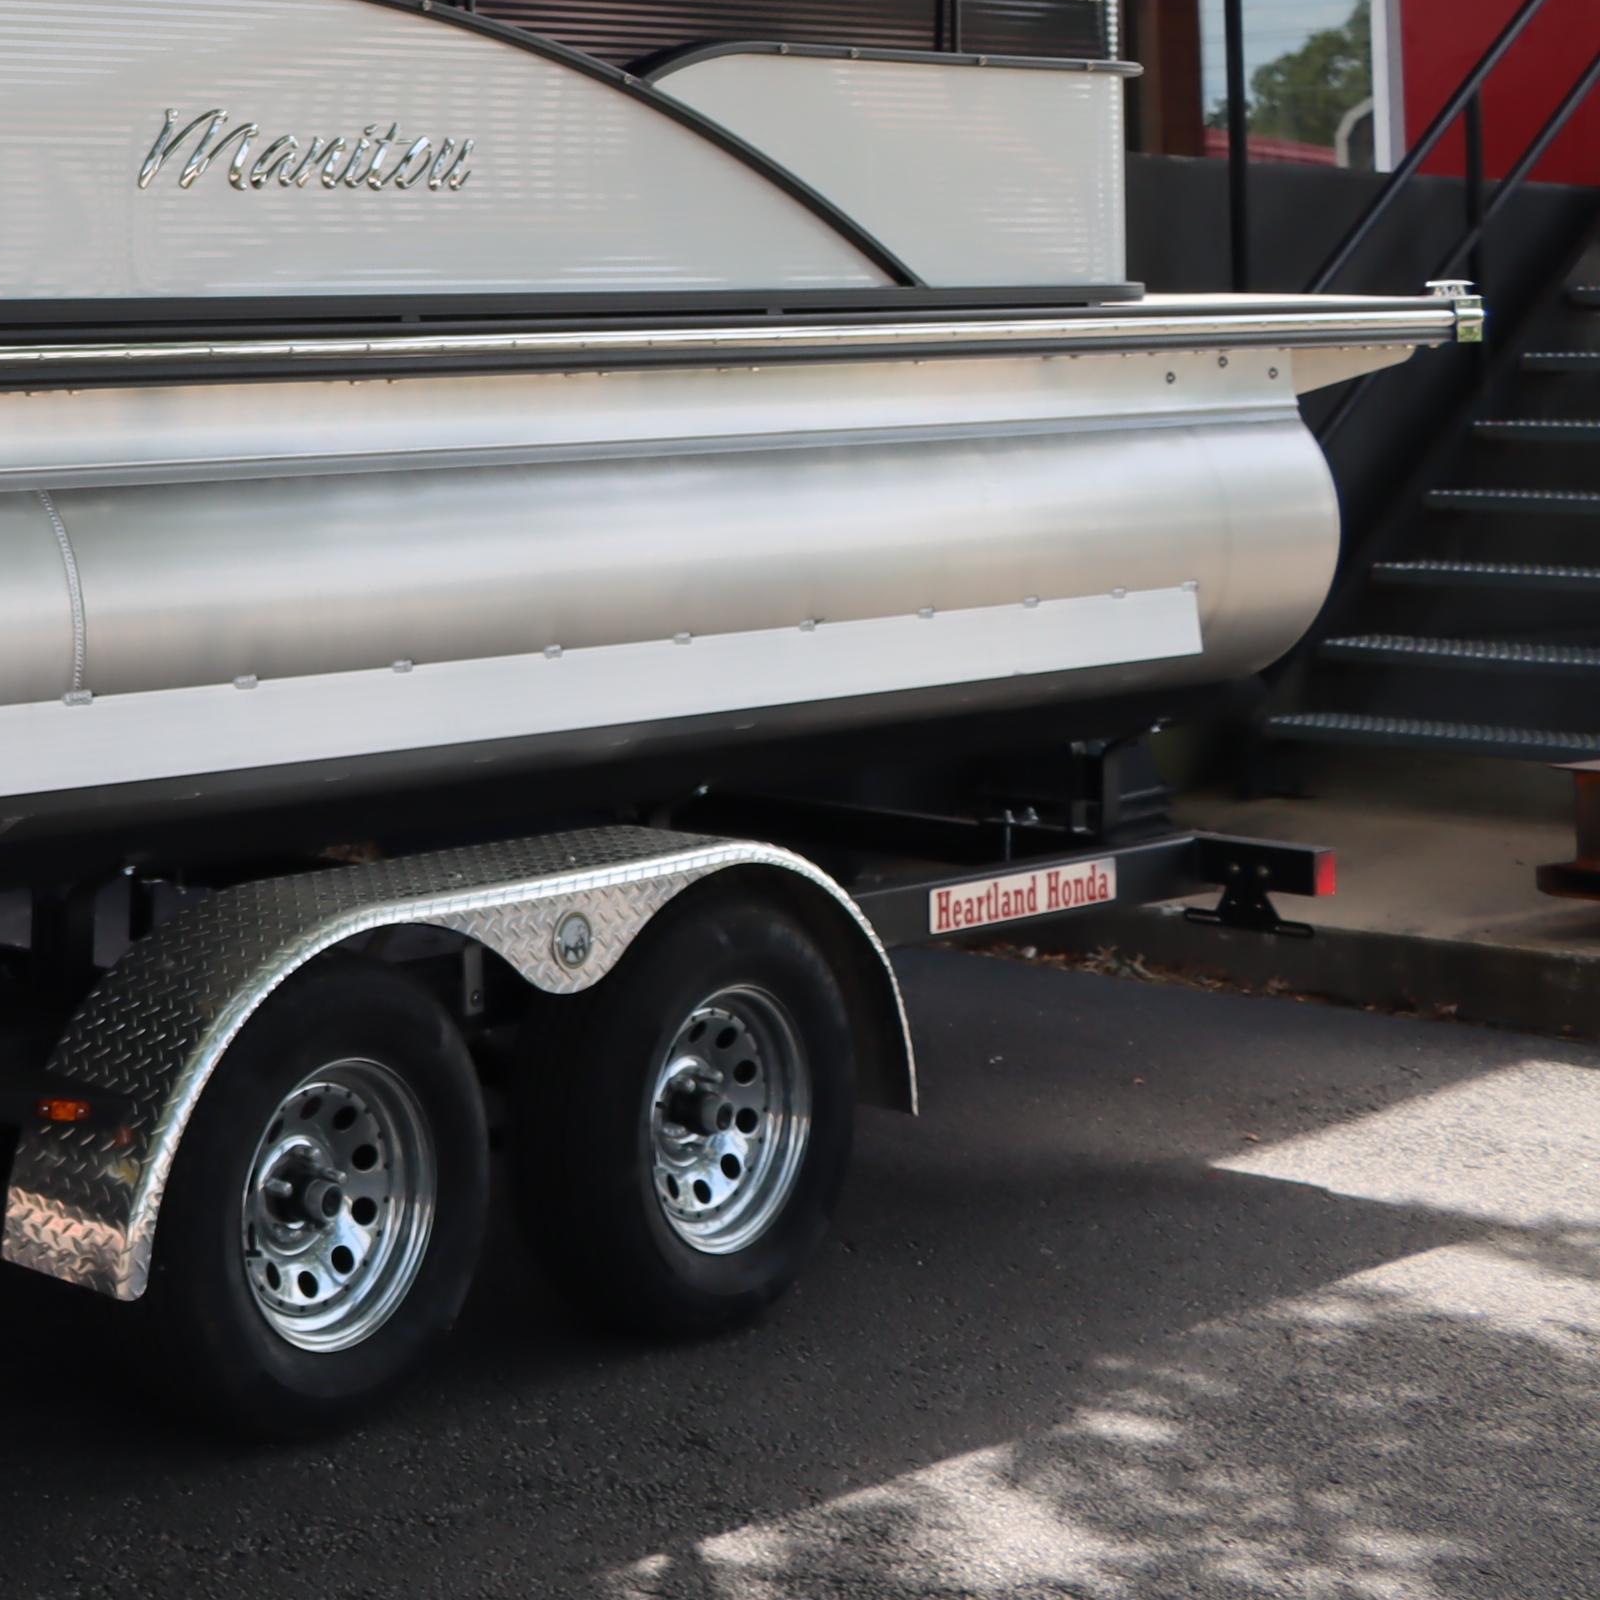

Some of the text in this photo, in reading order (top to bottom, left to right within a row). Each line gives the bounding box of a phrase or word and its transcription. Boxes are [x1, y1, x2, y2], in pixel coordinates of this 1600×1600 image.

[137, 107, 475, 191] Manitou
[936, 864, 1110, 931] Heartland Honda
